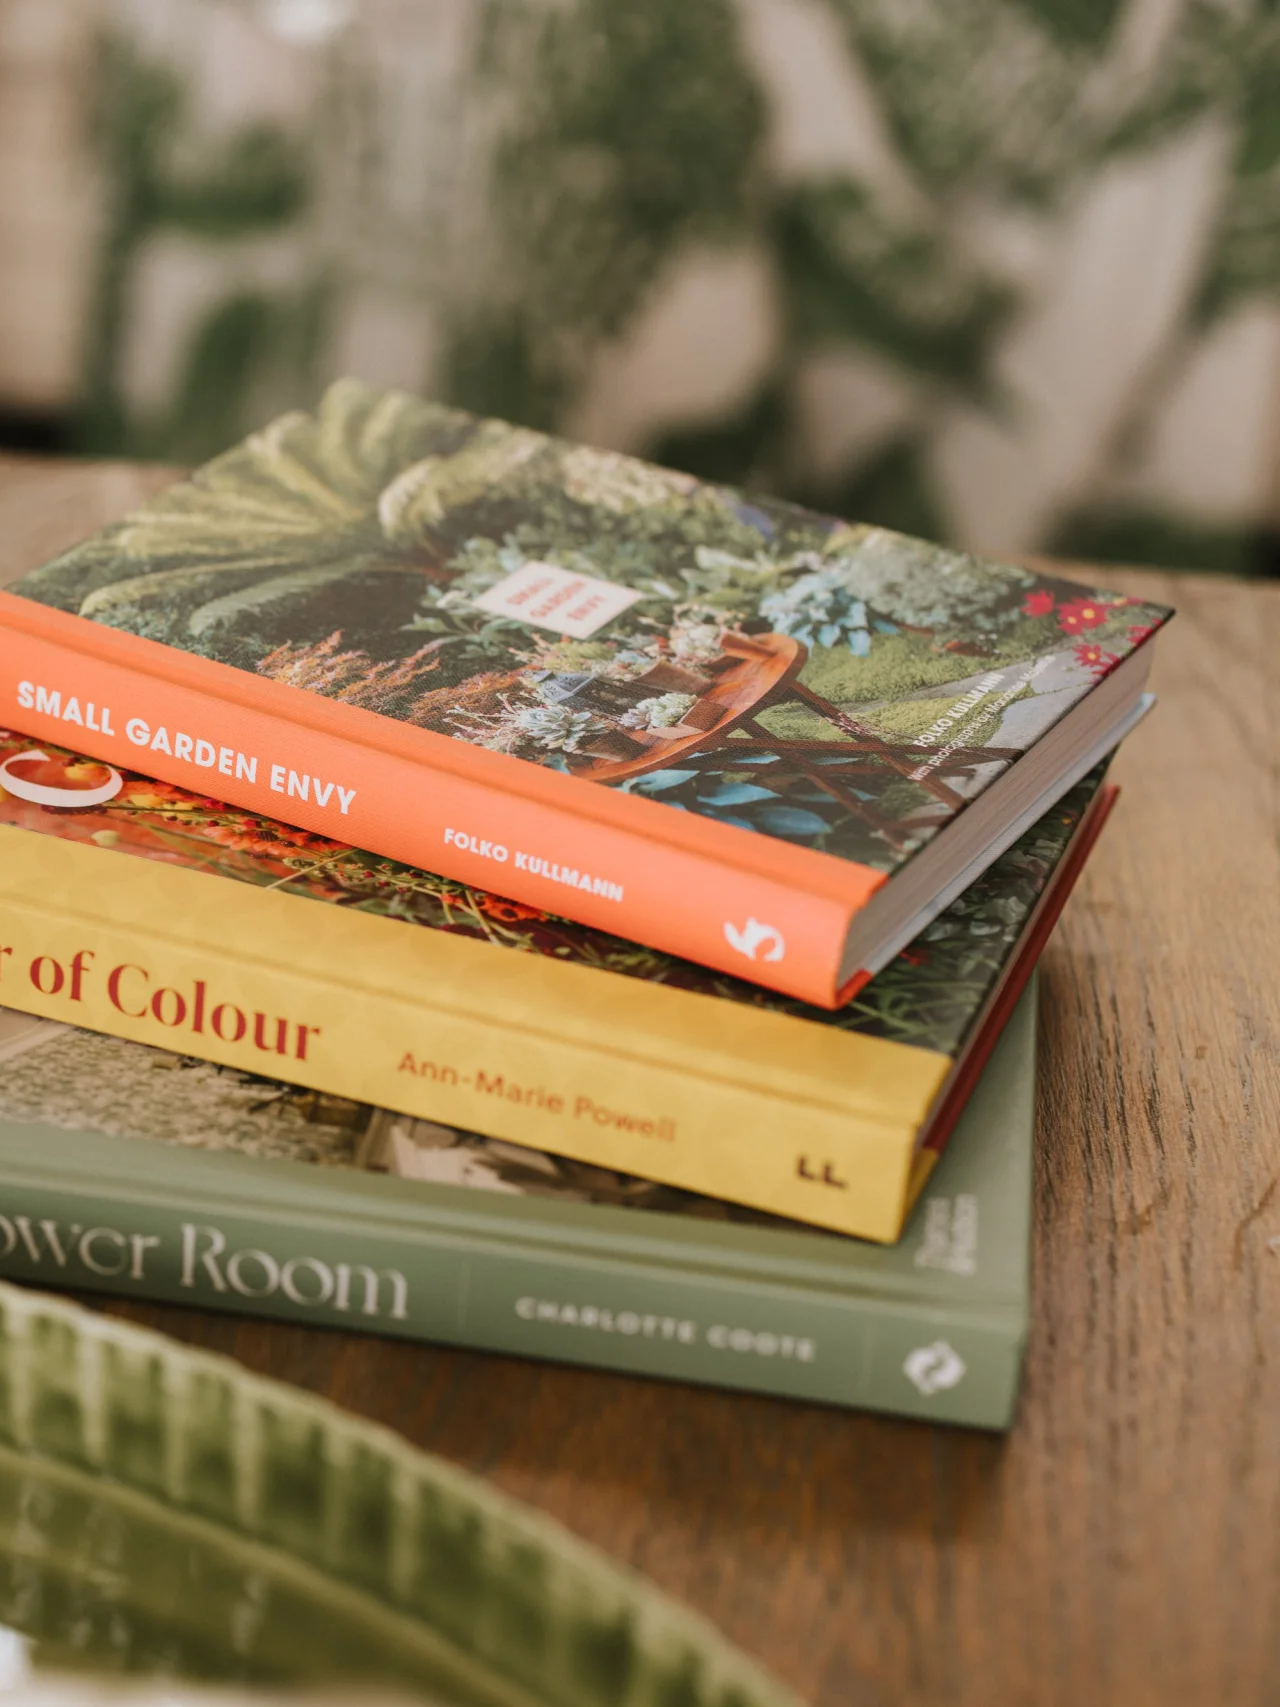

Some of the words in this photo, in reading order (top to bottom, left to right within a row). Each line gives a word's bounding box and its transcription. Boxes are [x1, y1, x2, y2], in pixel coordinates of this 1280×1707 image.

[17, 681, 115, 736] SMALL
[125, 718, 258, 784] GARDEN
[269, 766, 357, 815] ENVY
[913, 718, 953, 747] FOLKO
[946, 672, 1004, 719] KULLMANN
[443, 828, 509, 863] FOLKO
[514, 851, 624, 902] KULLMANN
[30, 950, 95, 1002] of
[107, 963, 321, 1061] Colour
[397, 1052, 565, 1114] Ann-Marie
[574, 1096, 677, 1142] Powell
[181, 1222, 410, 1320] Room
[515, 1296, 697, 1345] CHARLOTTE
[706, 1324, 817, 1363] COOTE
